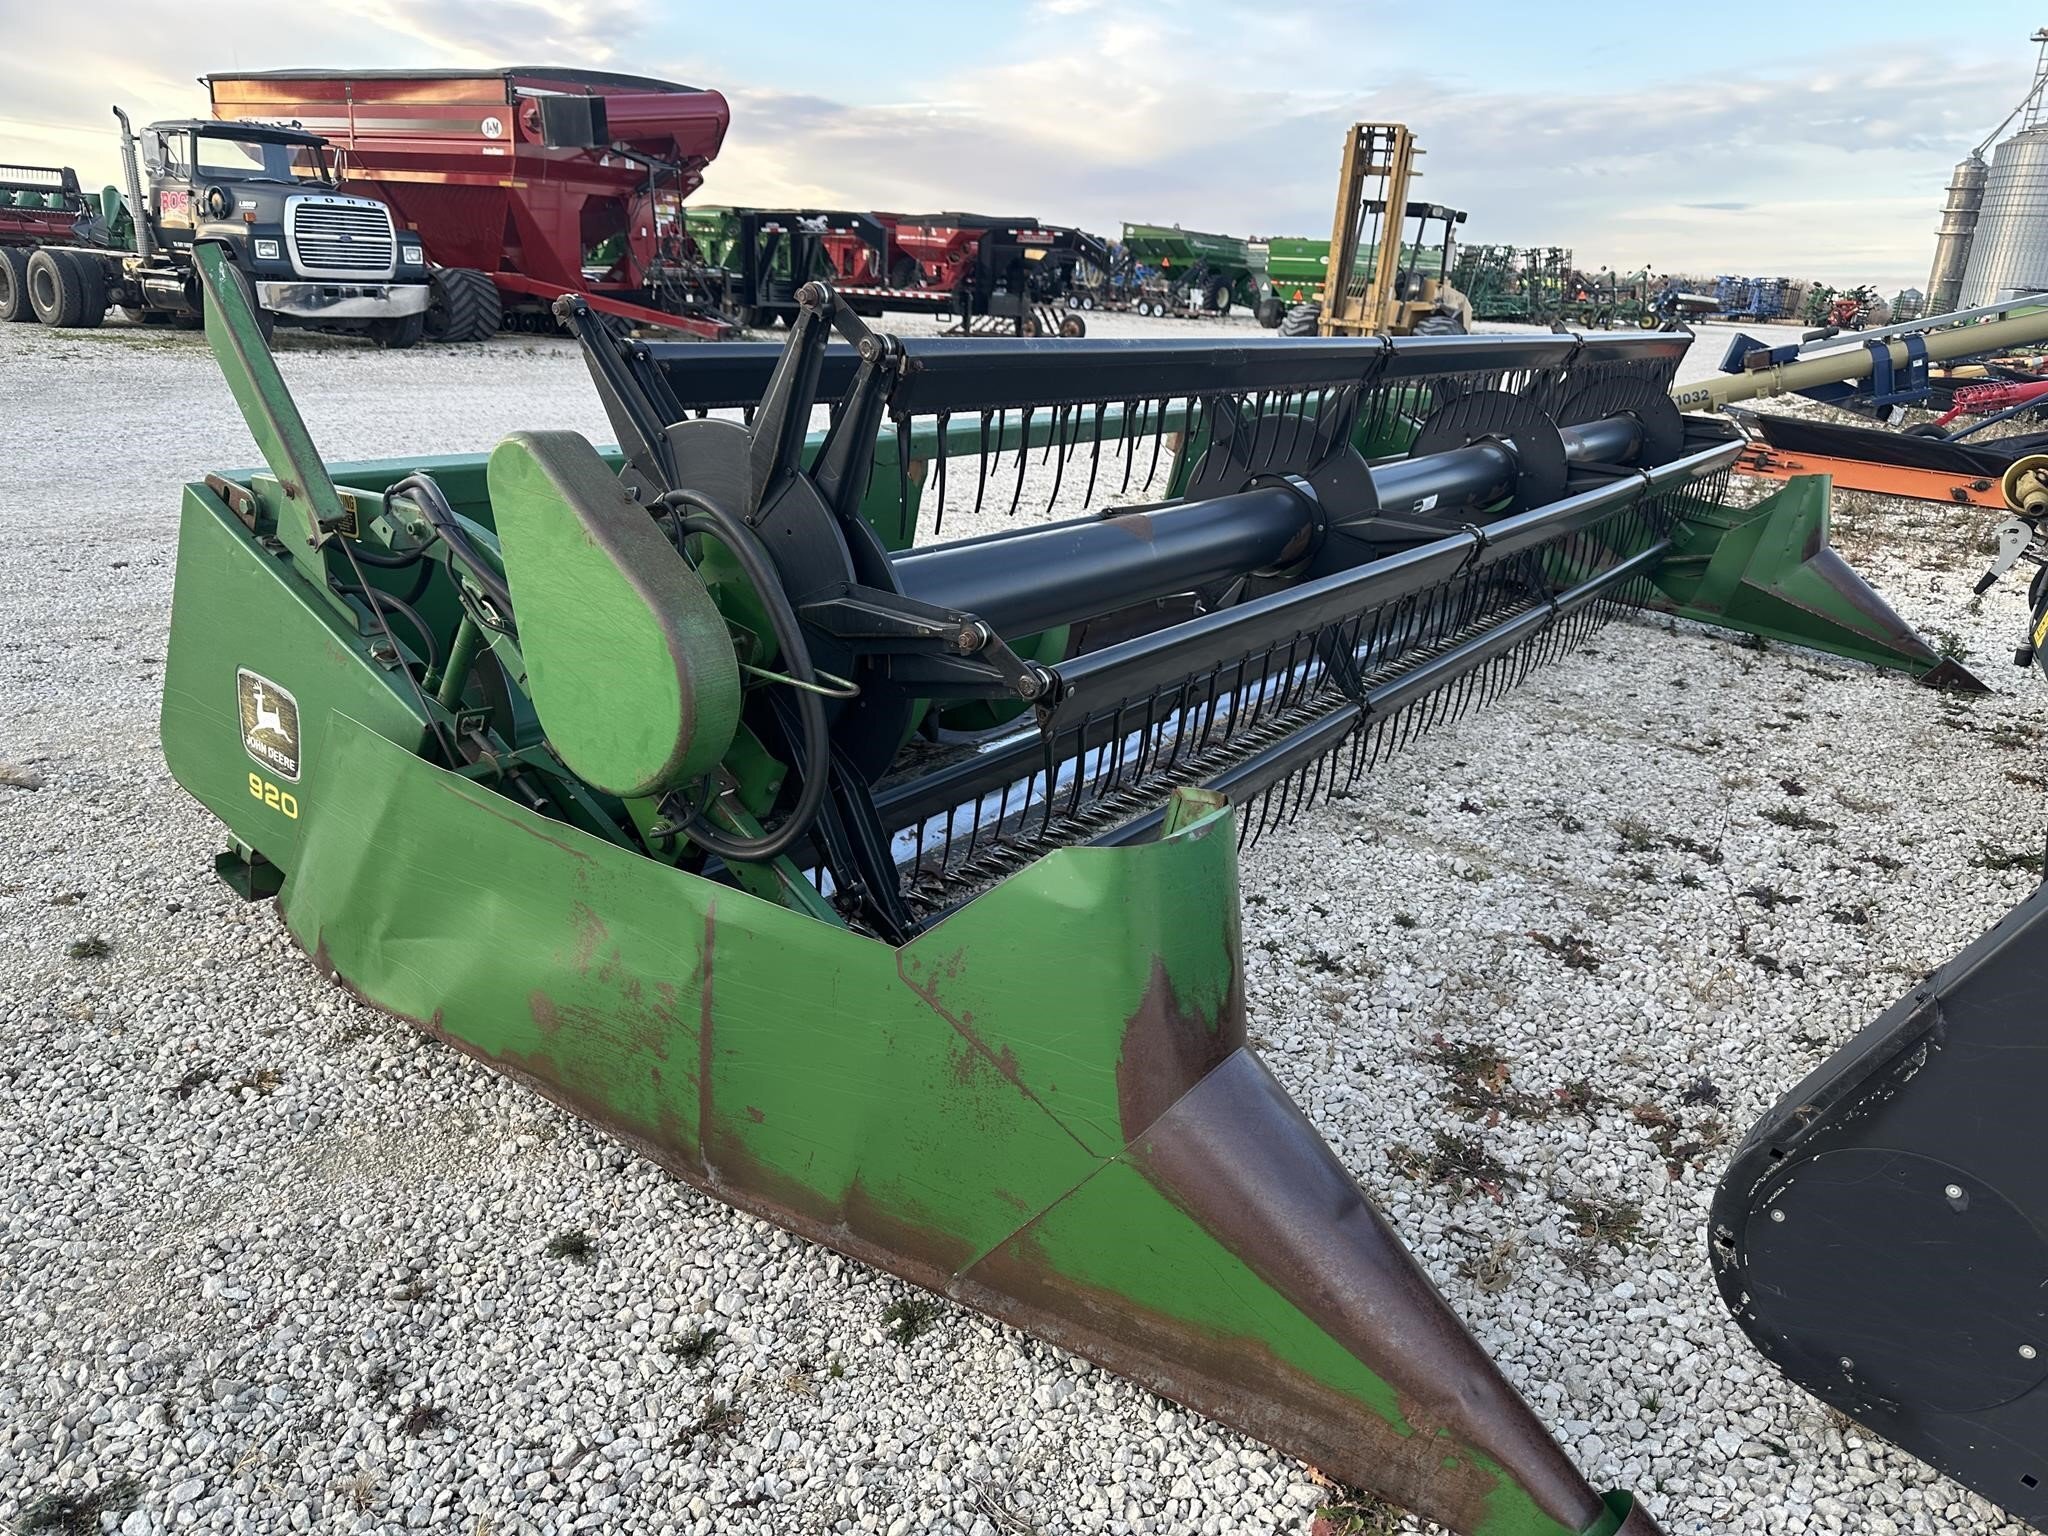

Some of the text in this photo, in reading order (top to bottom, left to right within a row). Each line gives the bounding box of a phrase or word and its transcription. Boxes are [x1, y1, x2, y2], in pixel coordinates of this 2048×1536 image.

[303, 196, 377, 207] FORD
[1671, 389, 1710, 406] 1032
[245, 734, 296, 771] JOHN DEERE
[248, 771, 299, 820] 920
